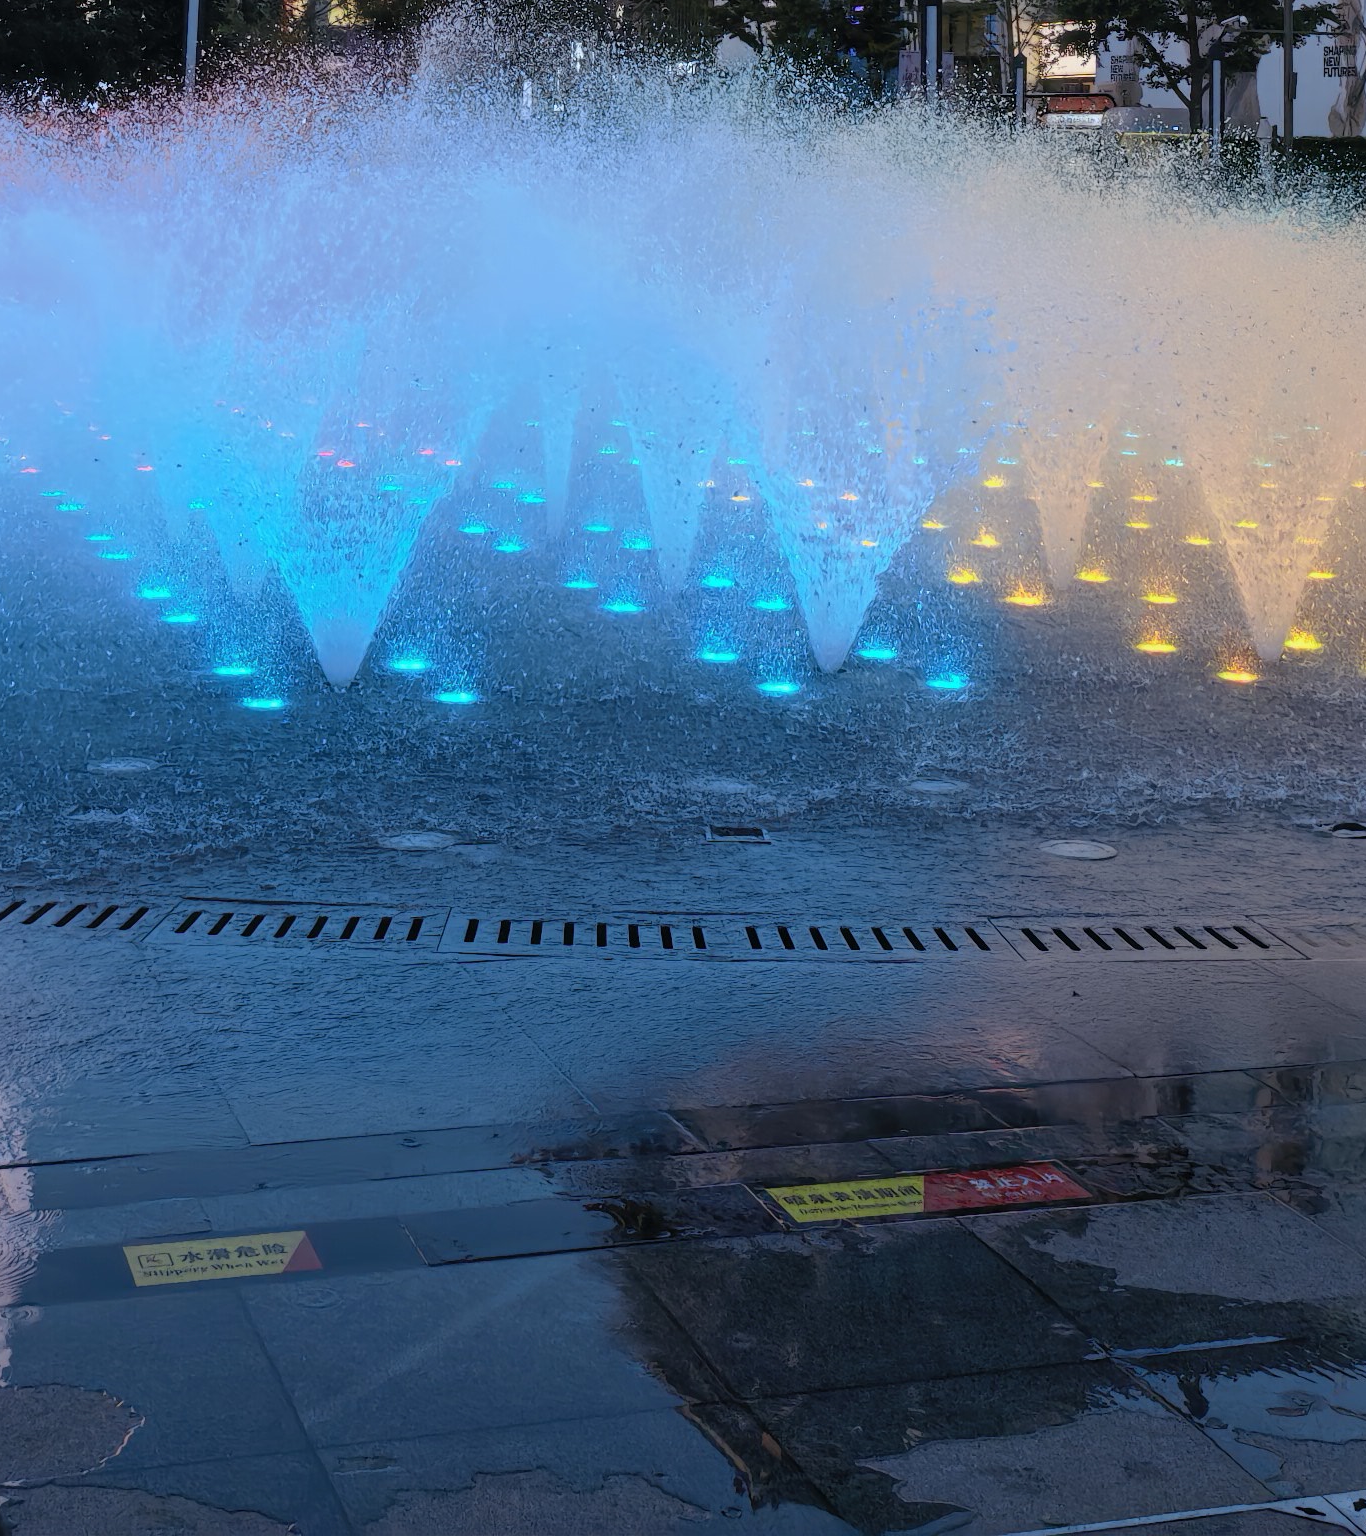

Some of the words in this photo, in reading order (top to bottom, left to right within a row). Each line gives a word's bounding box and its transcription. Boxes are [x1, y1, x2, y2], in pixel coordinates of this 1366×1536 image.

[1323, 57, 1341, 67] NEW
[178, 1242, 289, 1263] 水滑危险
